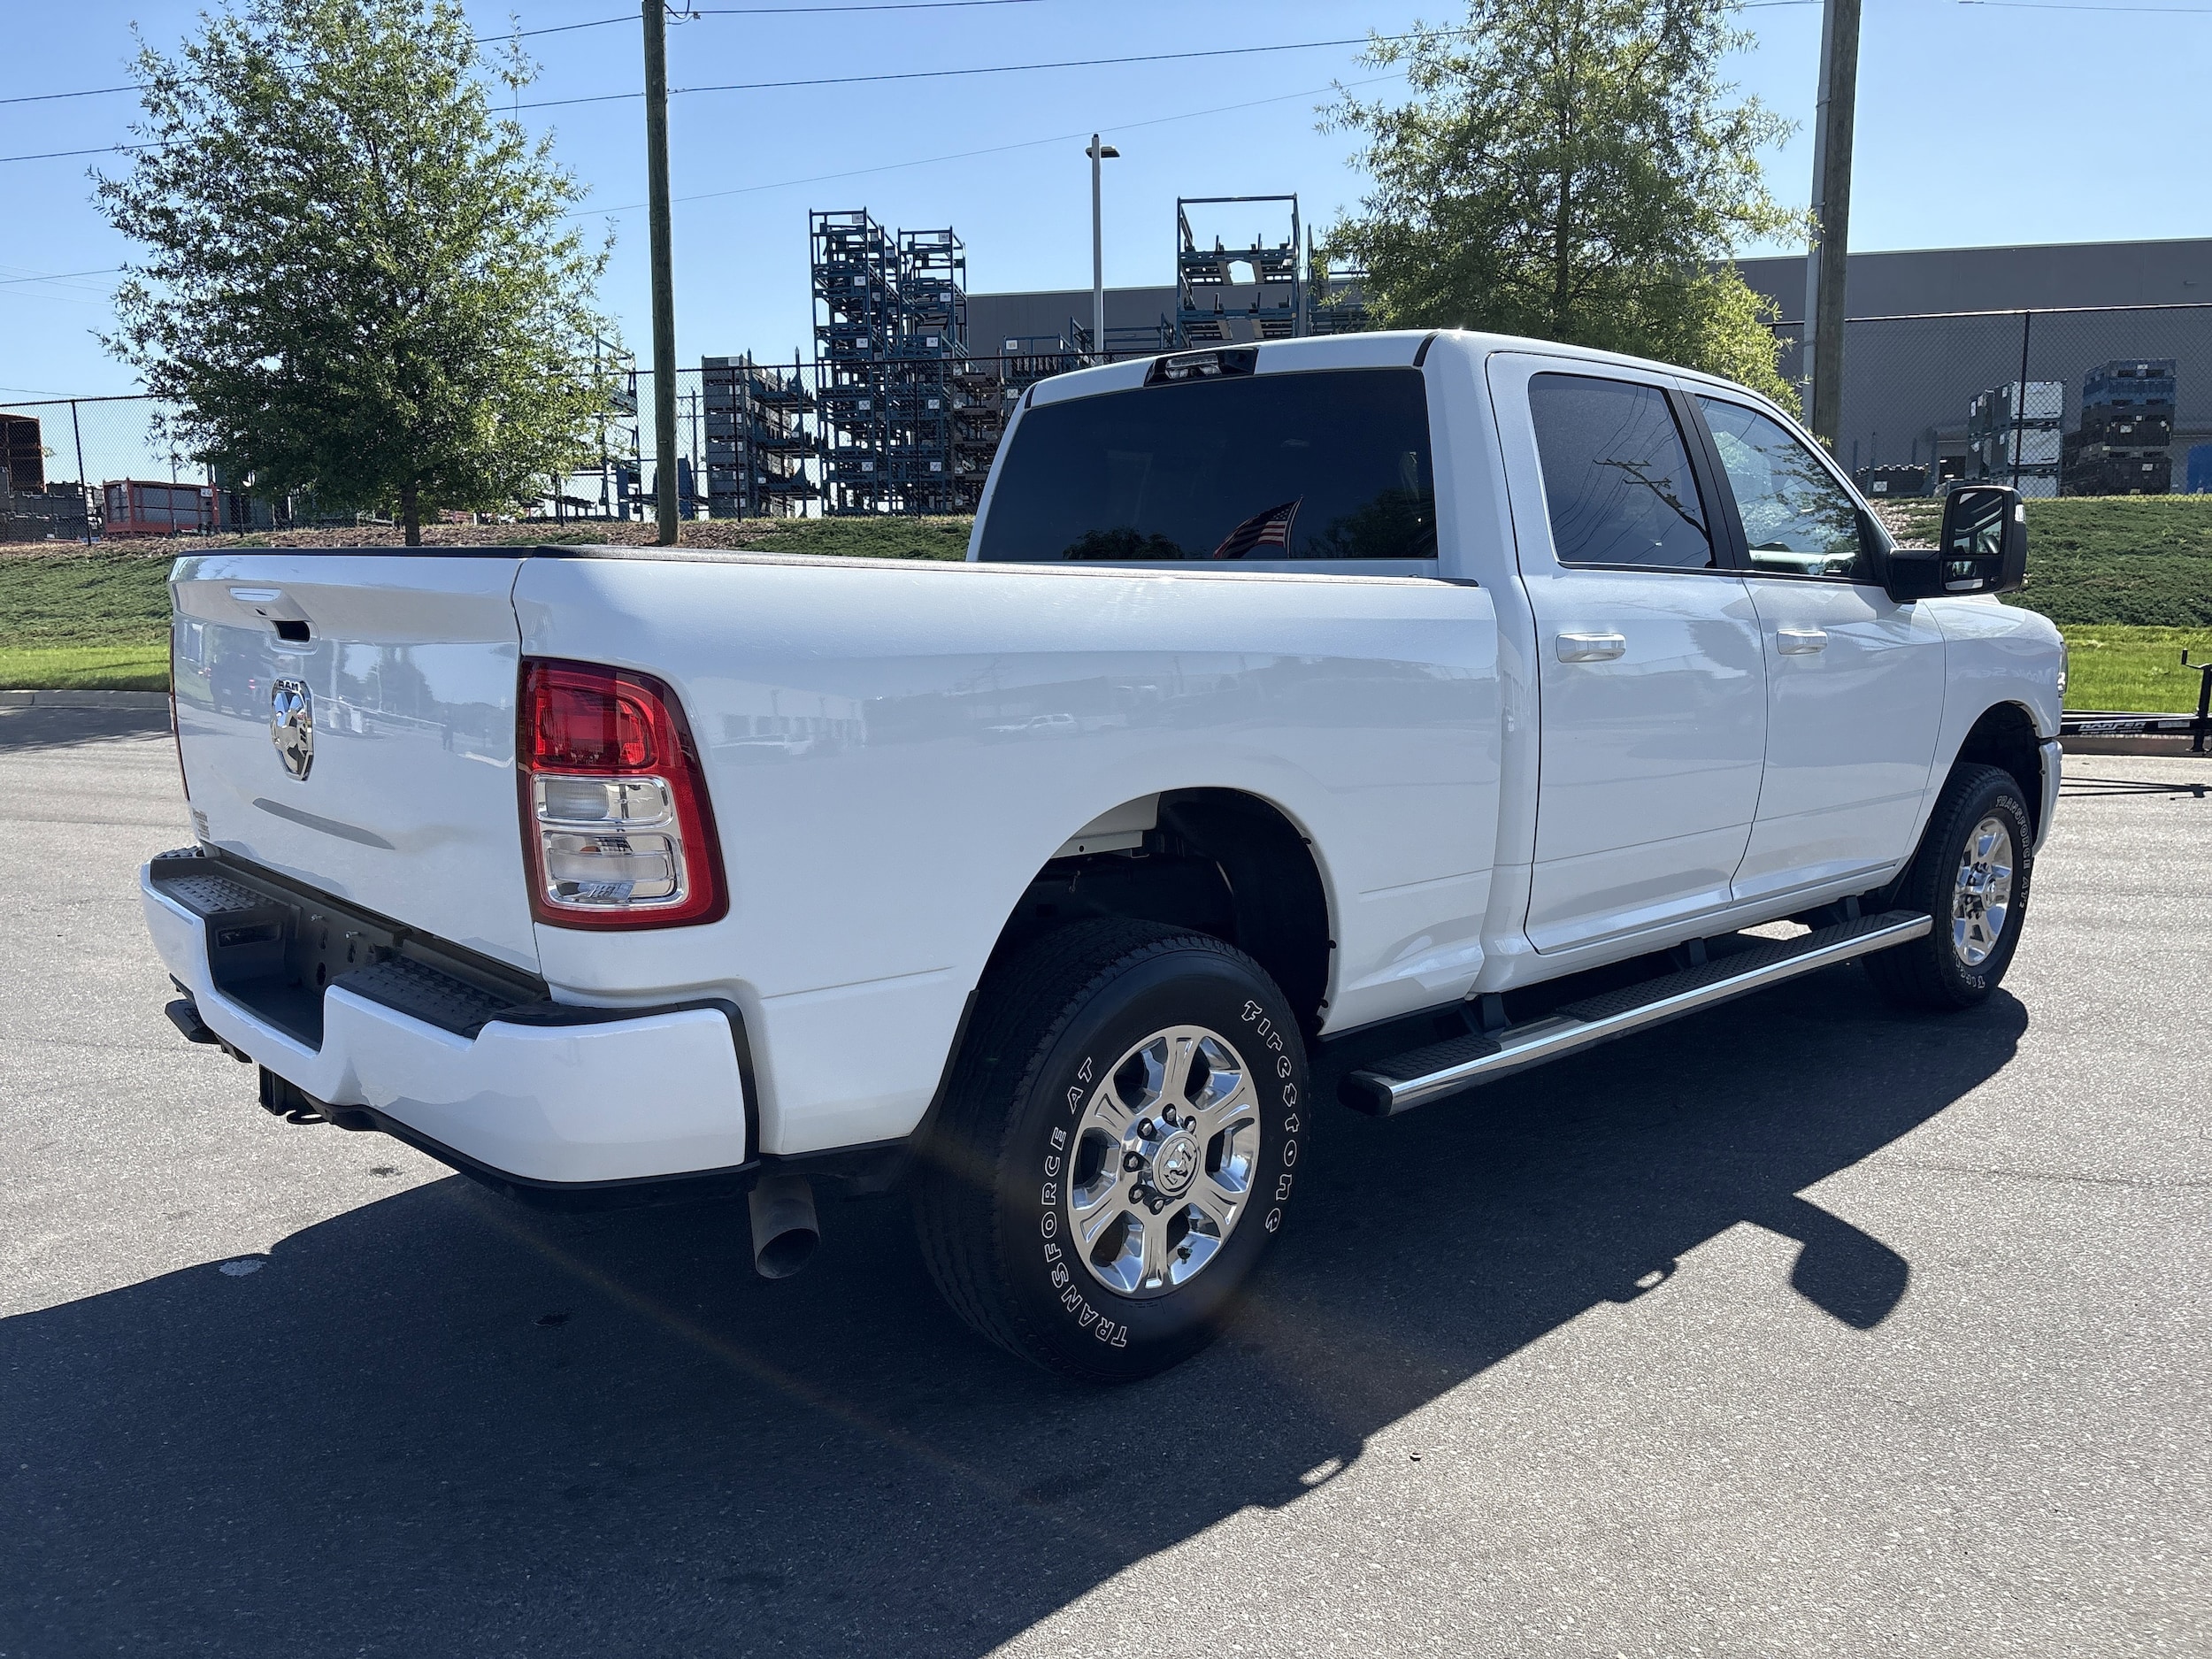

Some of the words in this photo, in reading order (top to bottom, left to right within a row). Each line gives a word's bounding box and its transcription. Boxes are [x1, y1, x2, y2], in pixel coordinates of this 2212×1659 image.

[278, 680, 299, 692] RAM
[1995, 795, 2032, 870] TRANSFORCE
[1066, 1056, 1093, 1115] AT
[1240, 1000, 1301, 1233] Firestone
[1041, 1126, 1128, 1348] TRANSFORCE
